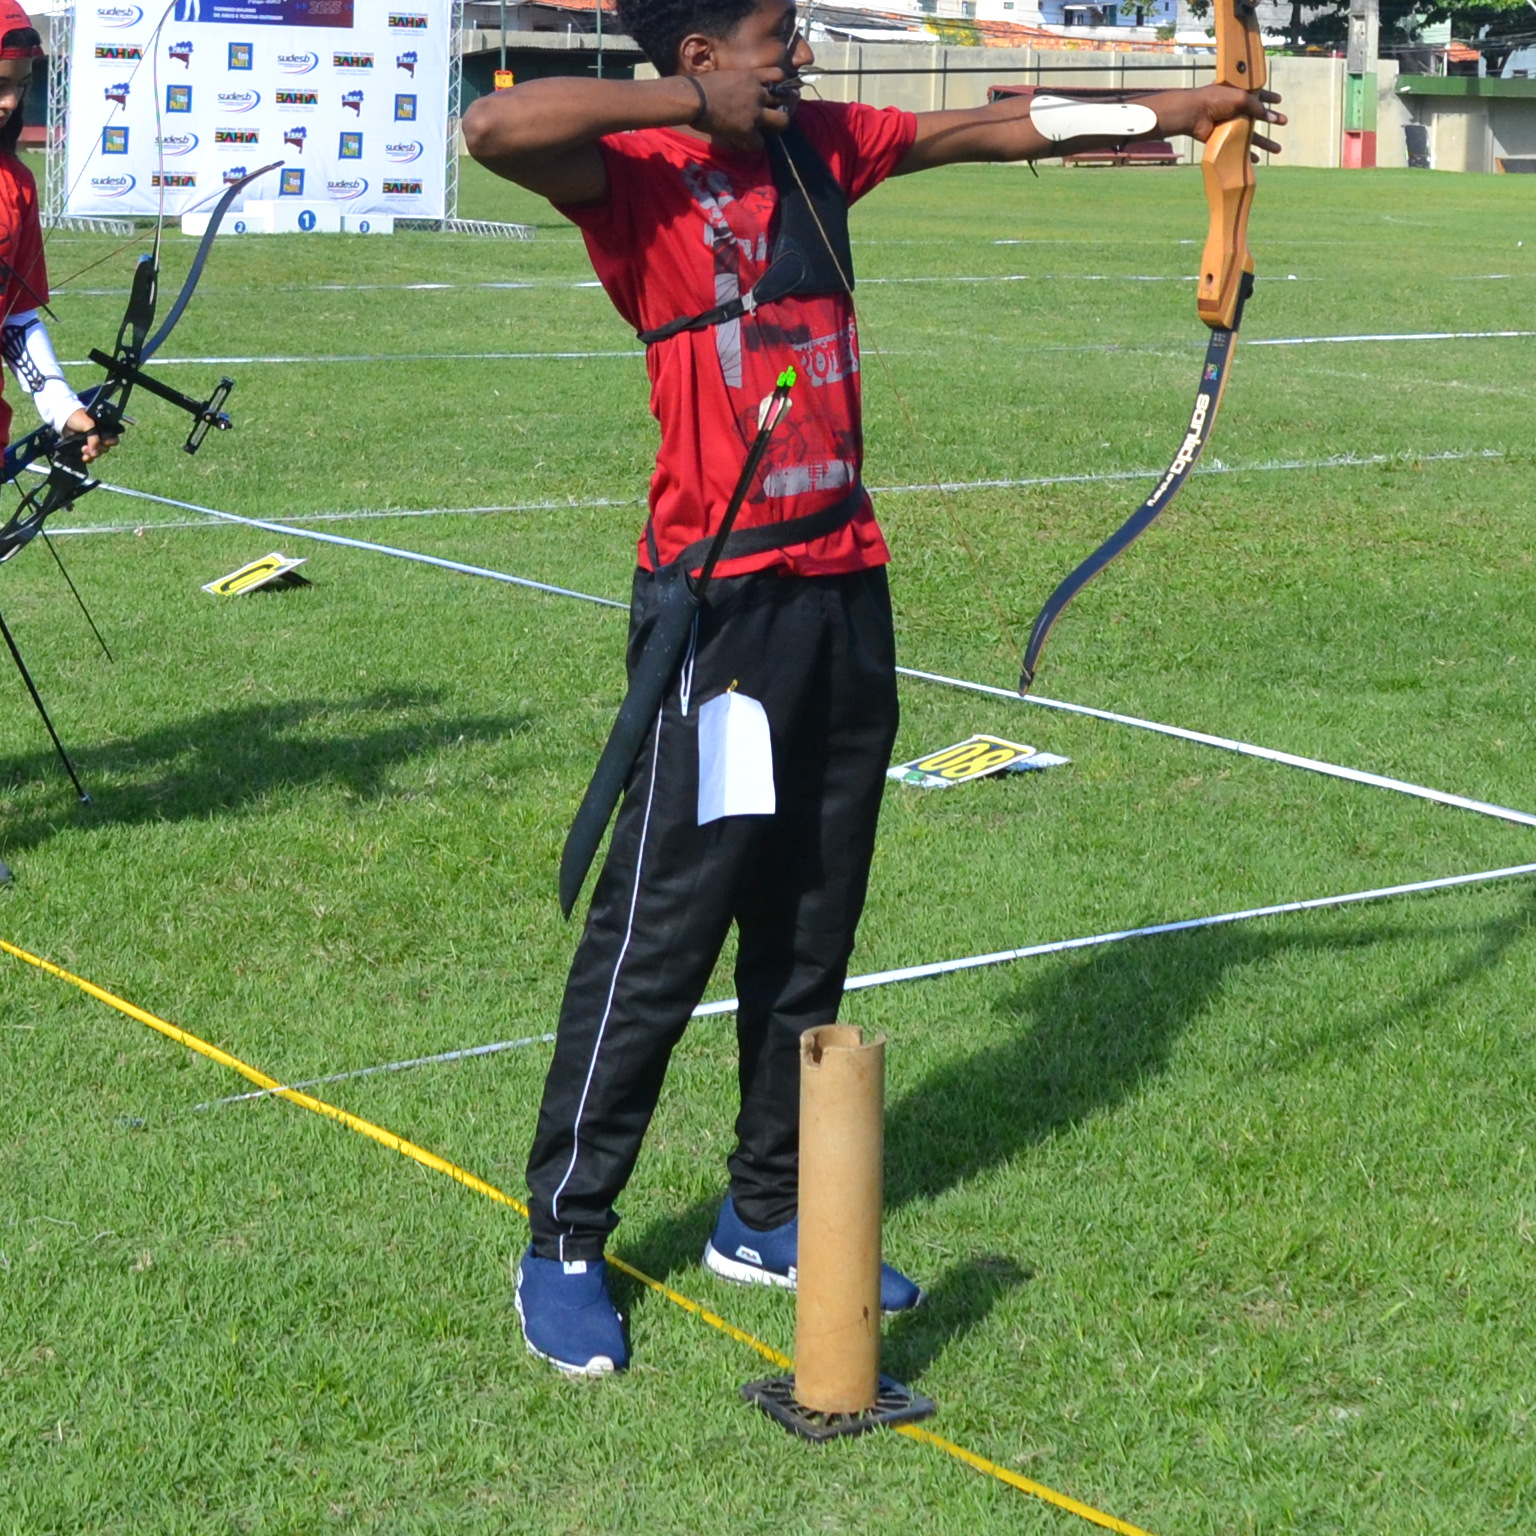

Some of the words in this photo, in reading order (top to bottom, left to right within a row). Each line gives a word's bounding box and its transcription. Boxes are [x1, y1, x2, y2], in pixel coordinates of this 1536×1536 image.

[97, 7, 134, 17] sudesb
[388, 16, 428, 29] BAHIA
[95, 47, 142, 60] BAHIA
[277, 53, 311, 63] sudesb
[333, 55, 374, 68] BAHIA
[217, 91, 252, 101] sudesb
[275, 92, 318, 105] BAHIA
[215, 131, 259, 144] BAHIA
[385, 142, 416, 152] sudesb
[91, 176, 127, 186] sudesb
[327, 180, 360, 189] sudesb
[382, 182, 422, 194] BAHIA
[1170, 393, 1210, 475] sanlida
[918, 743, 1016, 779] 08
